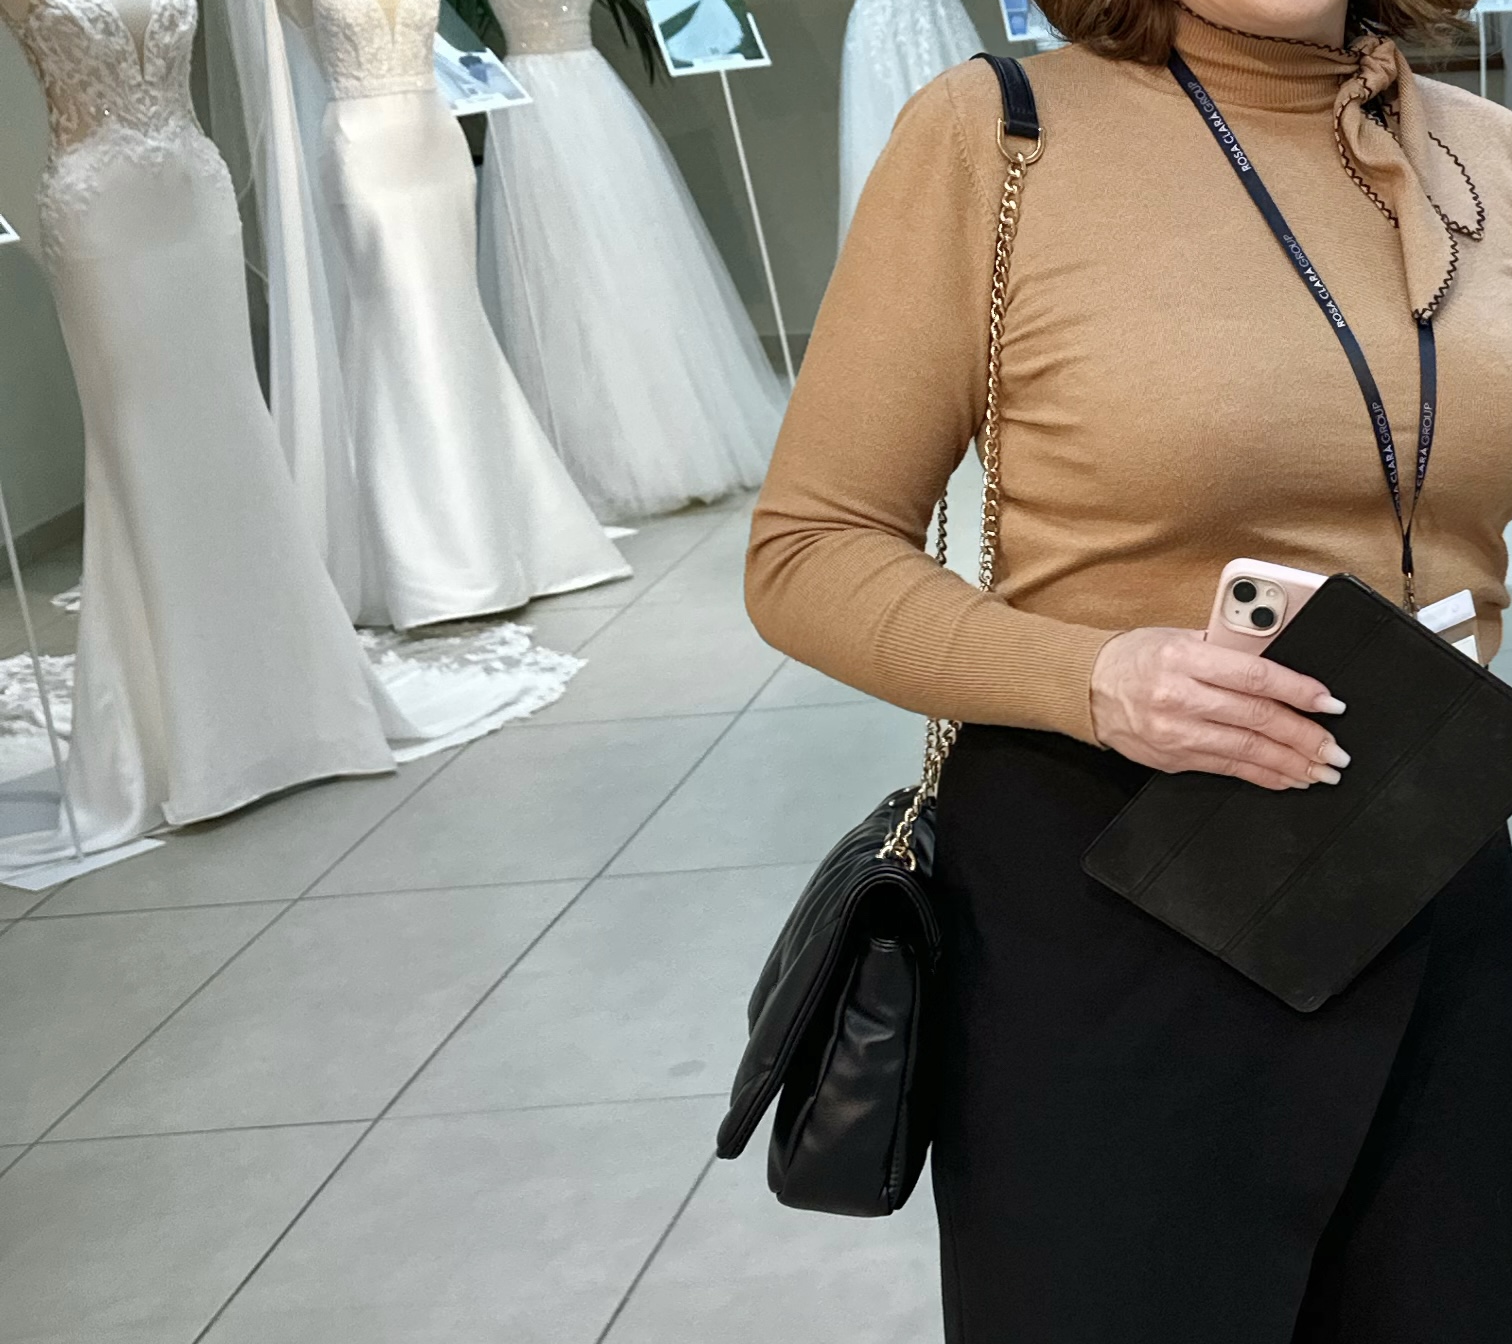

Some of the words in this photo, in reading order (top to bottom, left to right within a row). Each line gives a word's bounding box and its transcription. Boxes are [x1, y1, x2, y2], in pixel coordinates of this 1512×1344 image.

[1187, 81, 1215, 112] GROUP
[1230, 143, 1252, 172] ROSA
[1283, 234, 1309, 267] GROUP
[1326, 300, 1346, 328] ROSA
[1372, 402, 1391, 444] GROUP
[1421, 402, 1433, 446] GROUP
